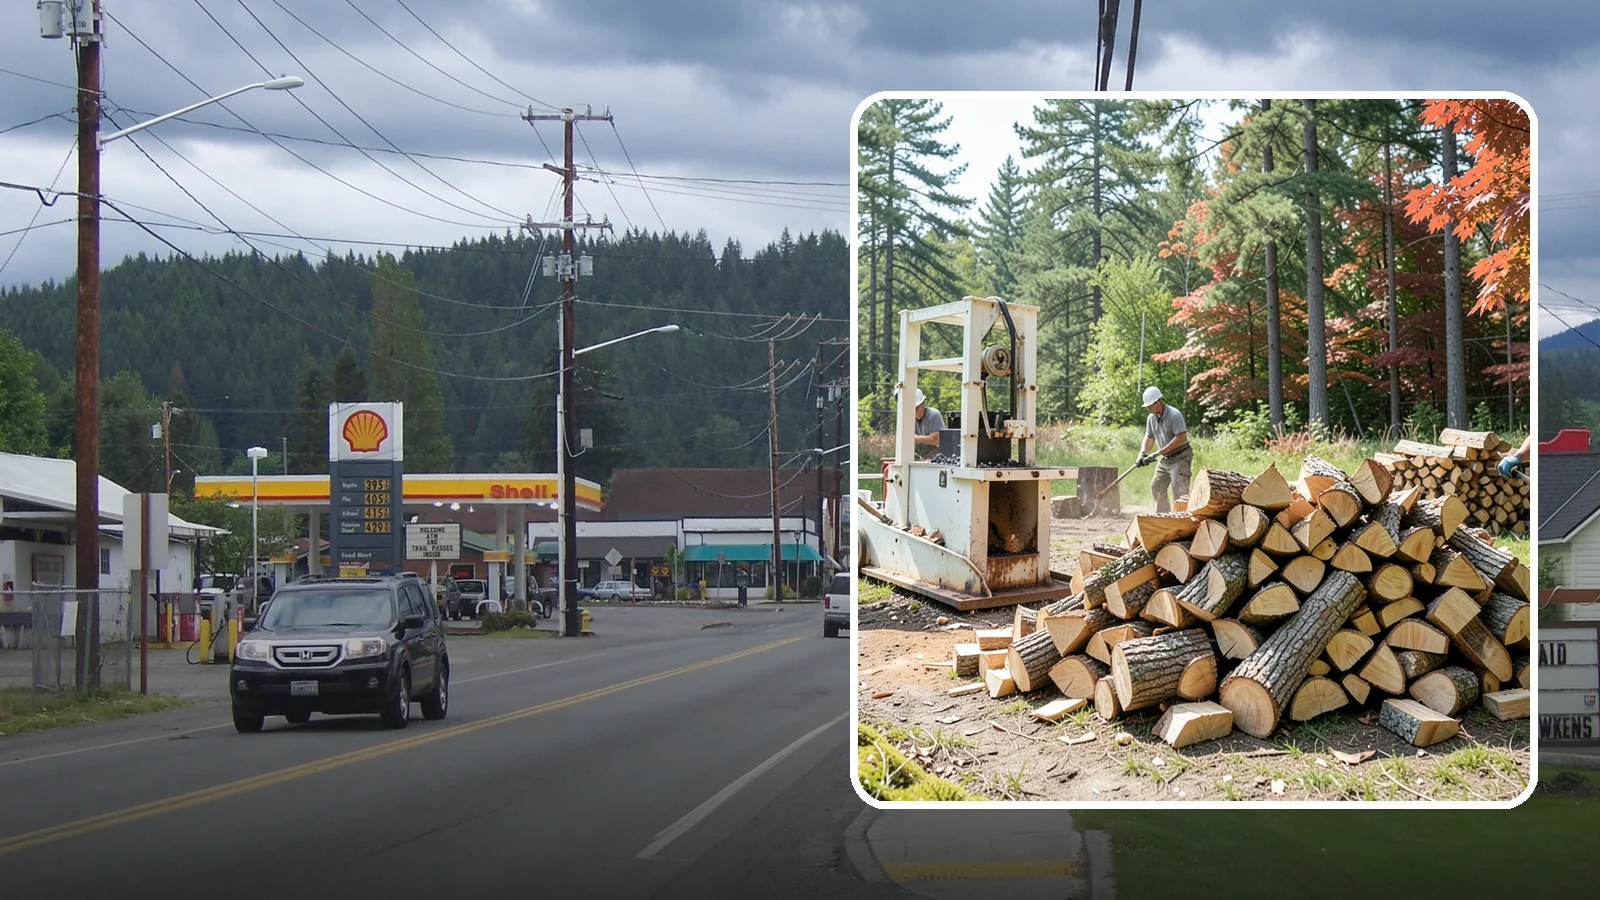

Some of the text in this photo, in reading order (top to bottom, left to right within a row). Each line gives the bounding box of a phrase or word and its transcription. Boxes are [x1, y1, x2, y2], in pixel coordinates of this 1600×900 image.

[490, 484, 547, 499] Shell
[365, 494, 383, 504] 405
[365, 508, 383, 518] 415
